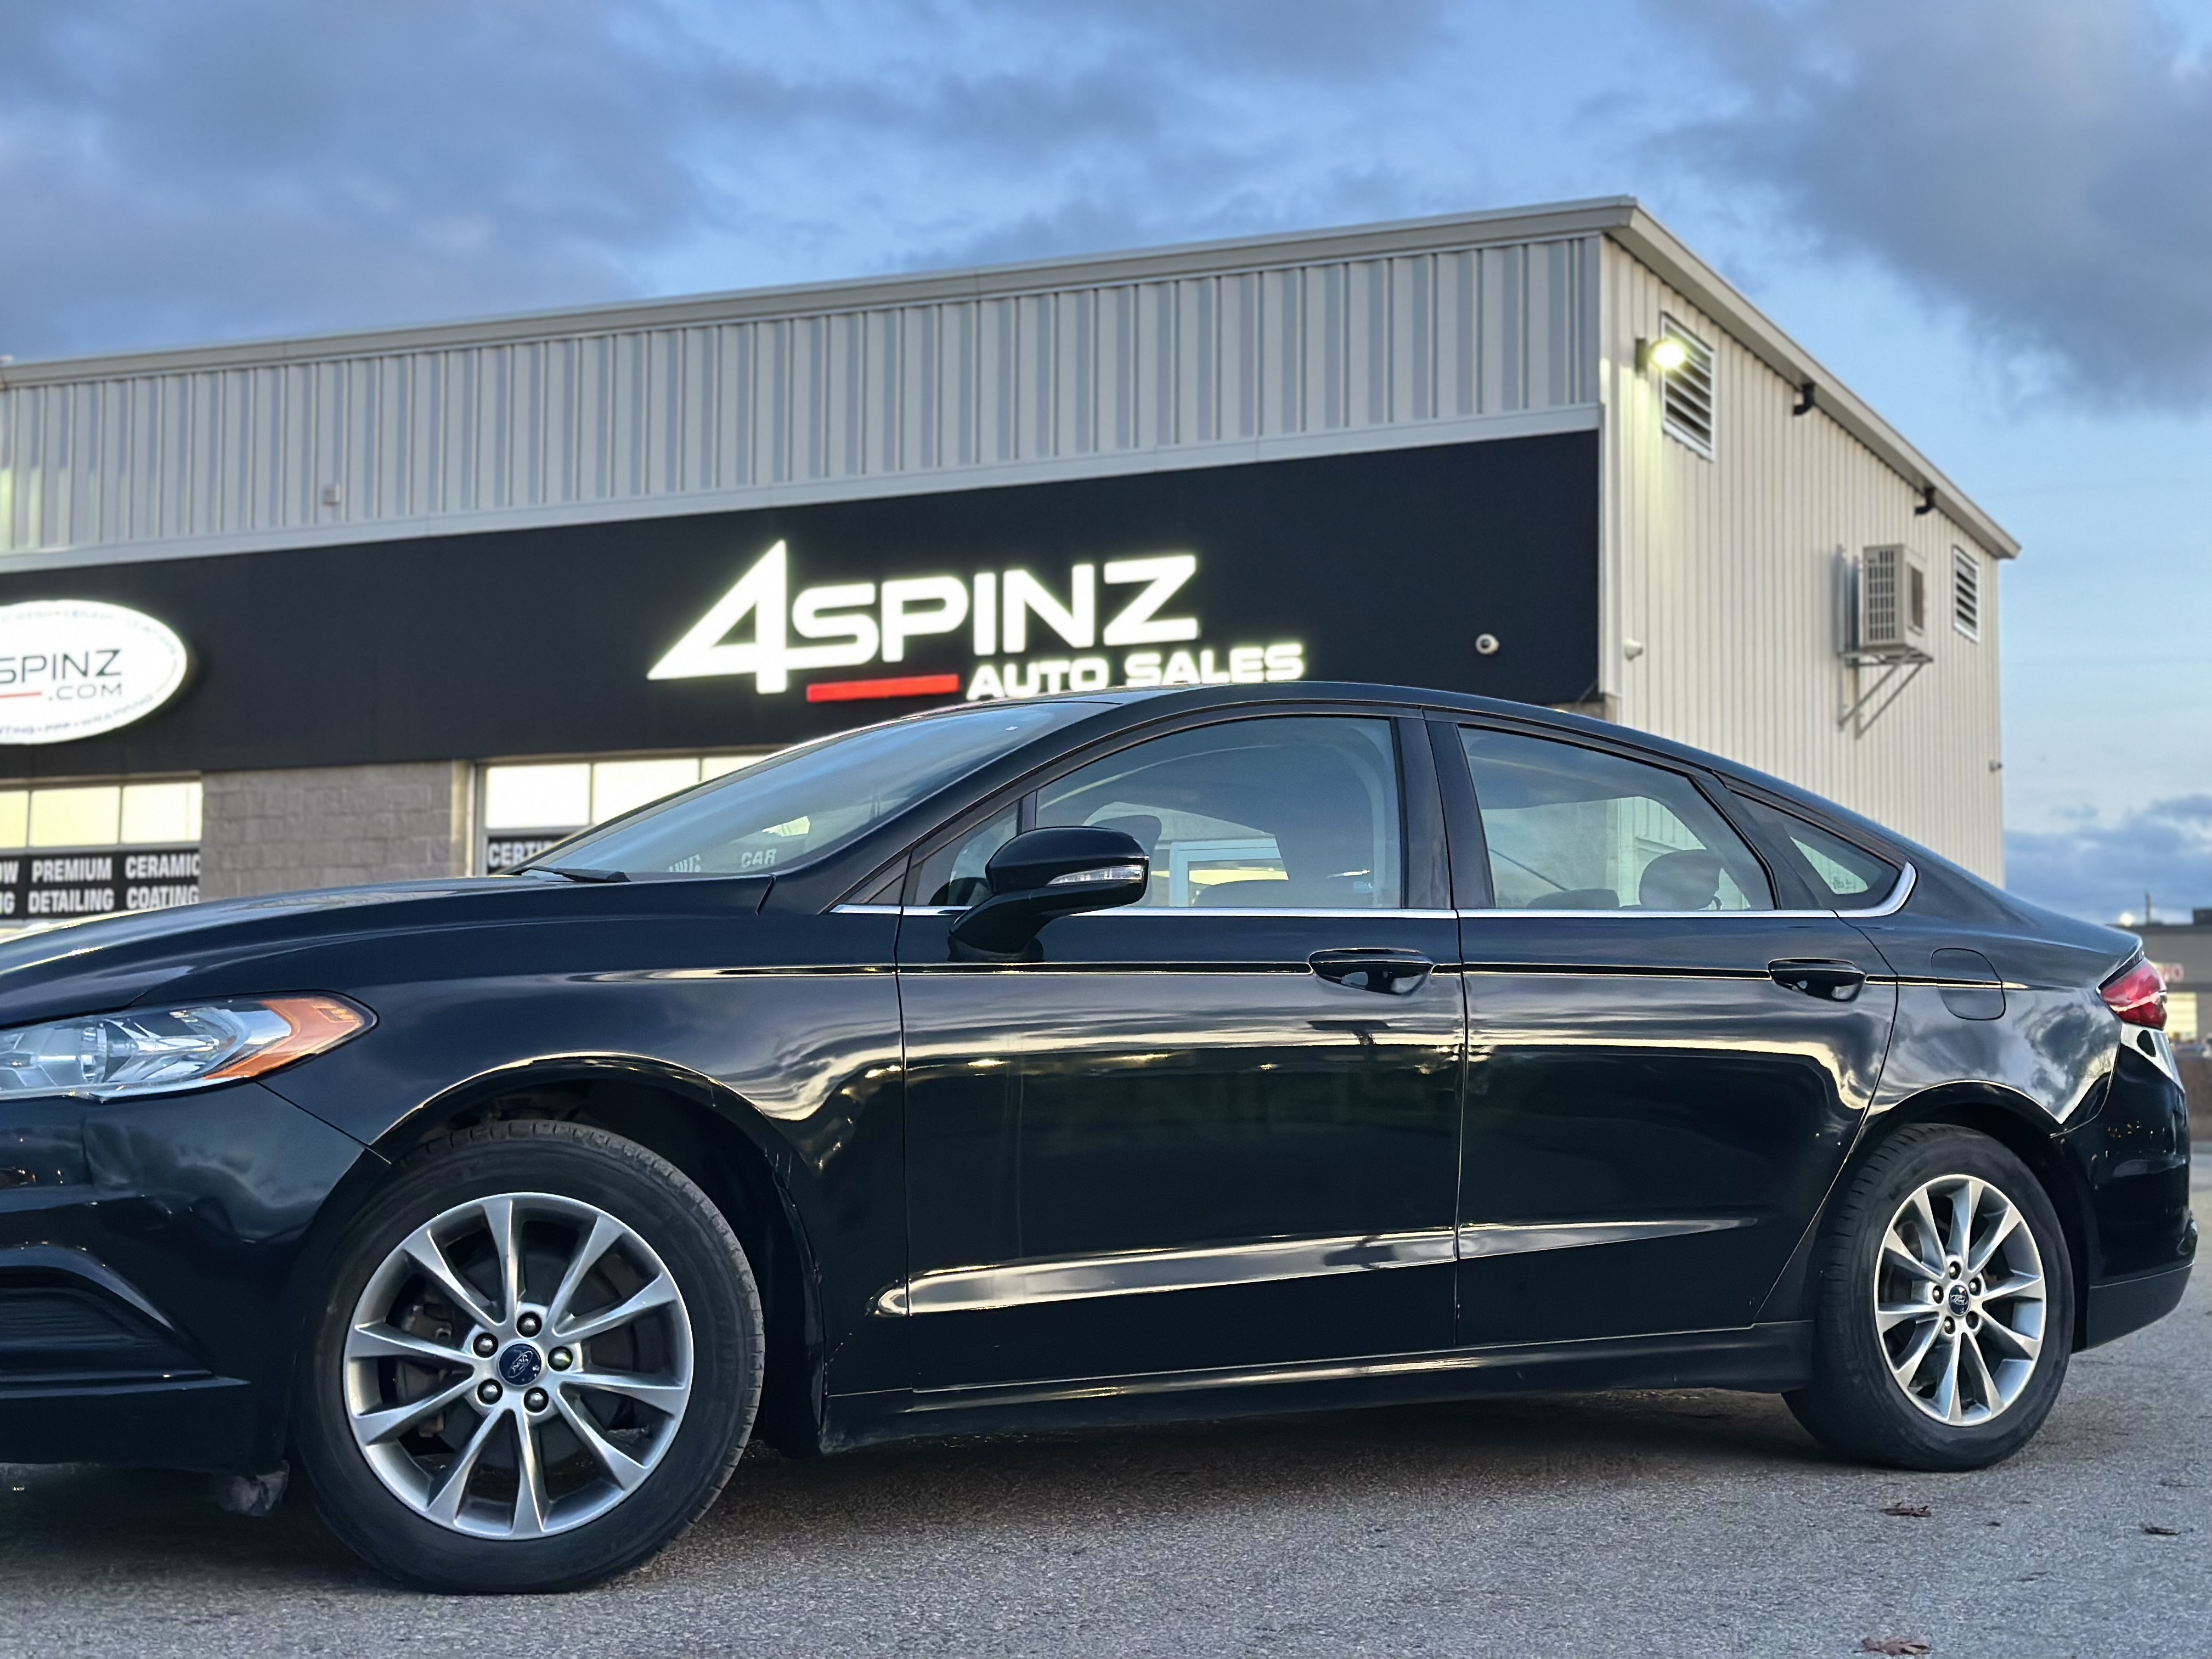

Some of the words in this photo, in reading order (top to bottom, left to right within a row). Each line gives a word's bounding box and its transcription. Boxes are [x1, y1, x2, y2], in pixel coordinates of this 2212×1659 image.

[646, 539, 1200, 694] 4SPINZ
[965, 657, 1110, 701] AUTO
[1124, 642, 1305, 687] SALES
[48, 683, 122, 701] .COM
[488, 840, 553, 868] CERT
[0, 860, 19, 884] W
[32, 857, 112, 883] PREMIUM
[125, 854, 201, 879] CERAMIC
[27, 888, 115, 913] DETAILING
[126, 885, 199, 910] COATING
